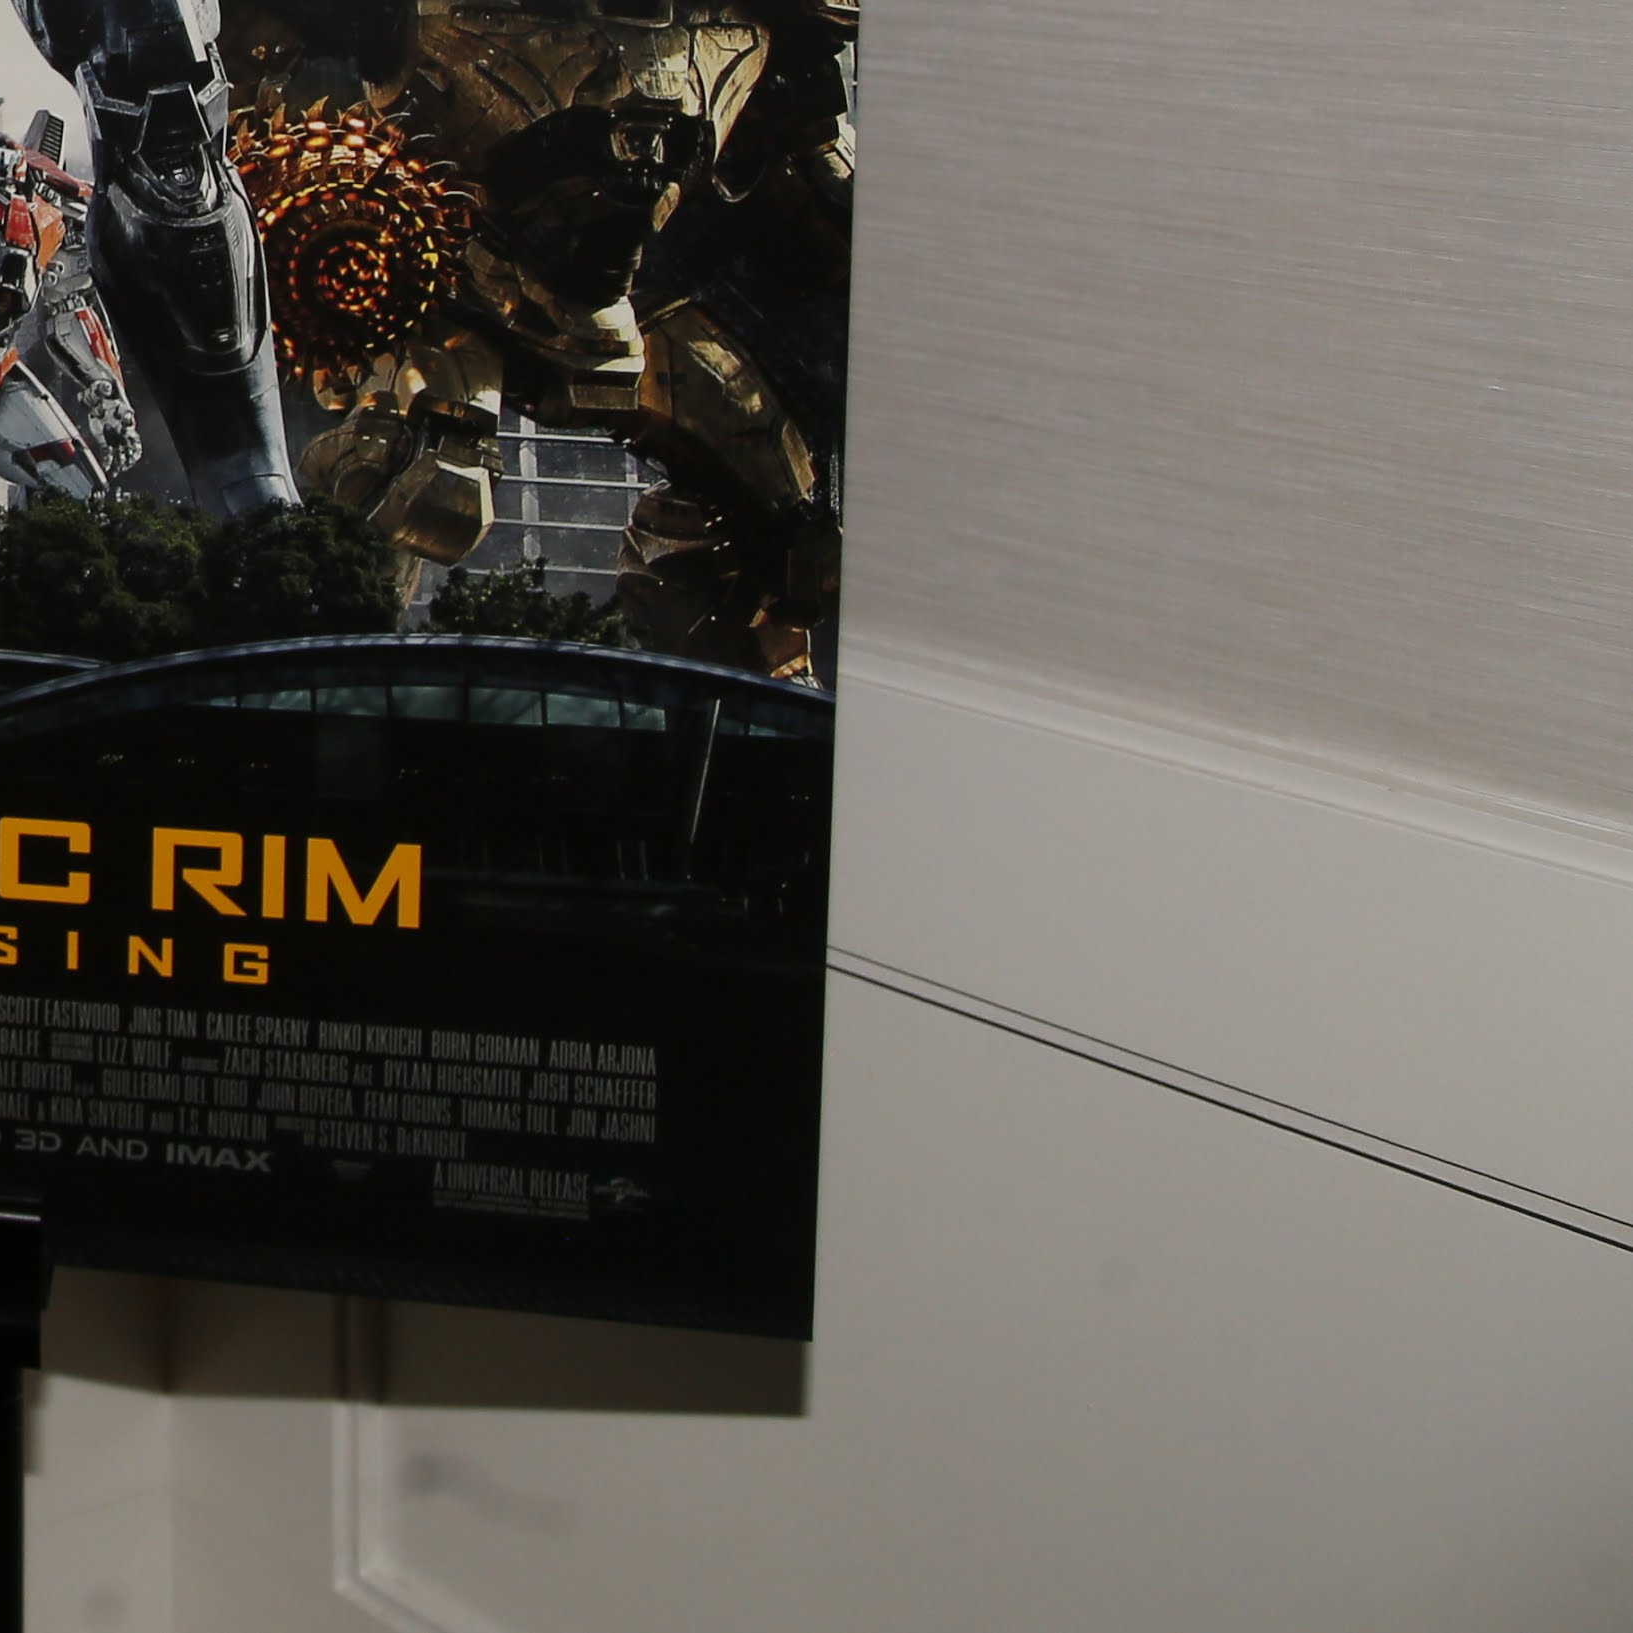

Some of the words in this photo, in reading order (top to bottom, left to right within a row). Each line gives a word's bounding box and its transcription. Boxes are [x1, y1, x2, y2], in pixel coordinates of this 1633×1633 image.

[151, 827, 422, 929] RIM
[0, 1027, 41, 1058] BALFE
[98, 1034, 128, 1064] LIZZ
[131, 1038, 172, 1069] WOLF
[223, 1045, 260, 1076] ZACH
[264, 1050, 349, 1084] STAENBERG
[383, 1058, 432, 1091] DYLAN
[436, 1062, 522, 1099] HIGHSMITH
[528, 1071, 569, 1102] JOSH
[574, 1075, 657, 1110] SCHAEFFER
[44, 998, 120, 1032] EASTWOOD
[129, 1006, 162, 1034] JING
[166, 1008, 197, 1038] TIAN
[206, 1010, 253, 1042] CAILEE
[255, 1014, 310, 1048] SPAENY
[318, 1019, 362, 1052] RINKO
[365, 1024, 422, 1057] KIKUCHI
[431, 1029, 471, 1061] BURN
[475, 1032, 540, 1066] GORMAN
[548, 1039, 592, 1071] ADRIA
[596, 1043, 656, 1077] ARJONA
[21, 1061, 72, 1093] BOYTER
[102, 1068, 180, 1103] GUILLERMO
[183, 1074, 207, 1105] DEL
[212, 1077, 248, 1108] TORO
[256, 1080, 296, 1112] JOHN
[299, 1083, 354, 1117] BOYEGA
[363, 1089, 399, 1121] FEMI
[460, 1097, 521, 1132] THOMAS
[526, 1103, 558, 1136] TULL
[566, 1107, 597, 1138] JON
[600, 1111, 656, 1144] JASHNI
[50, 1095, 84, 1126] KIRA
[88, 1099, 144, 1132] SNYDER
[207, 1110, 268, 1144] NOWLIN
[318, 1118, 373, 1152] STEVEN
[14, 1128, 63, 1153] 3D
[75, 1135, 149, 1162] AND
[165, 1141, 275, 1174] IMAX
[432, 1161, 444, 1189] A
[446, 1161, 527, 1198] UNIVERSAL
[529, 1168, 591, 1202] RELEASE
